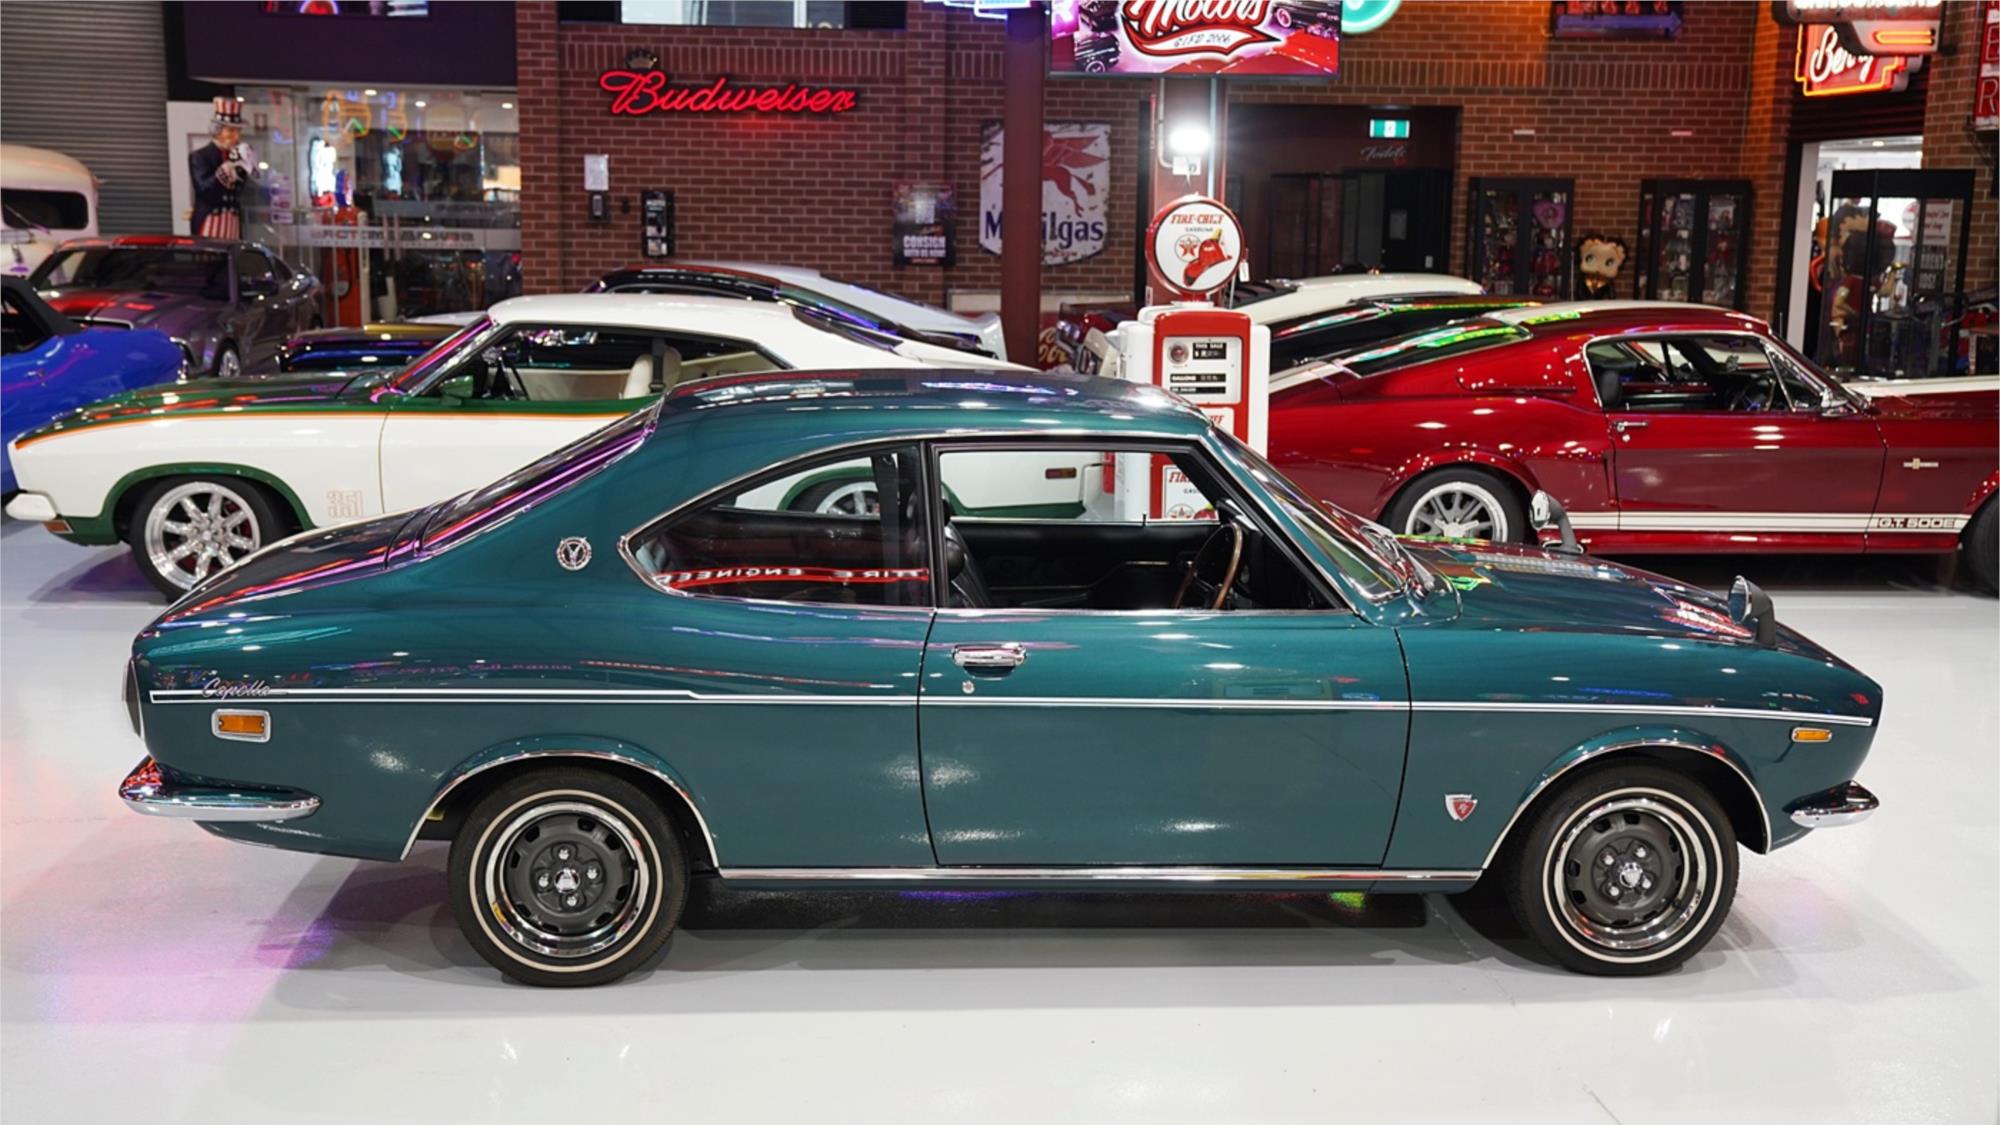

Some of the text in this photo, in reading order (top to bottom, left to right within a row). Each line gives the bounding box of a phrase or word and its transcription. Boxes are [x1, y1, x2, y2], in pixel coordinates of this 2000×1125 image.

[1127, 0, 1264, 36] Motors
[600, 70, 856, 114] Budweiser
[985, 211, 1104, 249] Milgas
